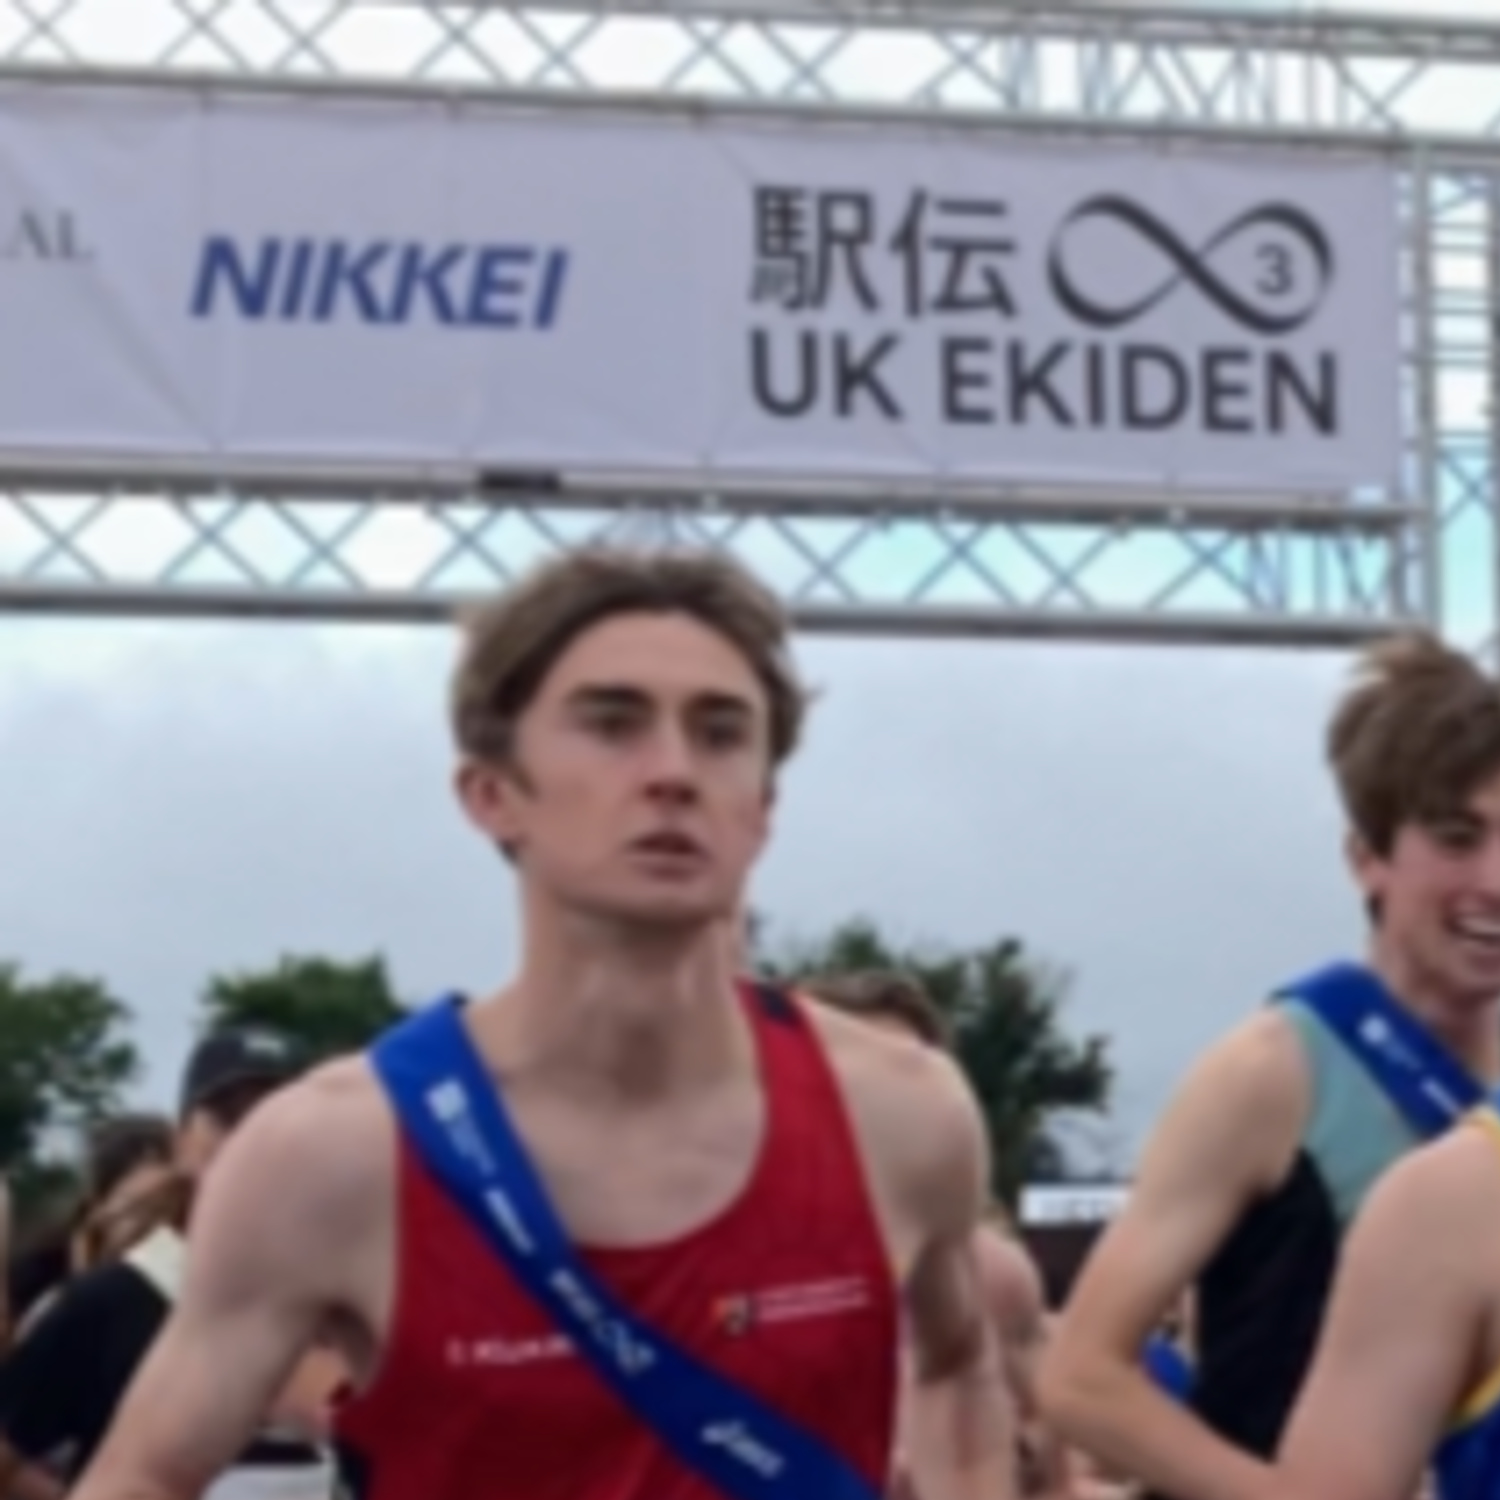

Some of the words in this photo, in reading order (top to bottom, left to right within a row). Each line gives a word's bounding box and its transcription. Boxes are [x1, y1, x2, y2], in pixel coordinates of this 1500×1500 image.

[190, 236, 570, 331] NIKKEI
[751, 186, 1017, 320] 駅伝
[1254, 242, 1295, 298] 3
[751, 328, 903, 420] UK
[941, 335, 1338, 437] EKIDEN
